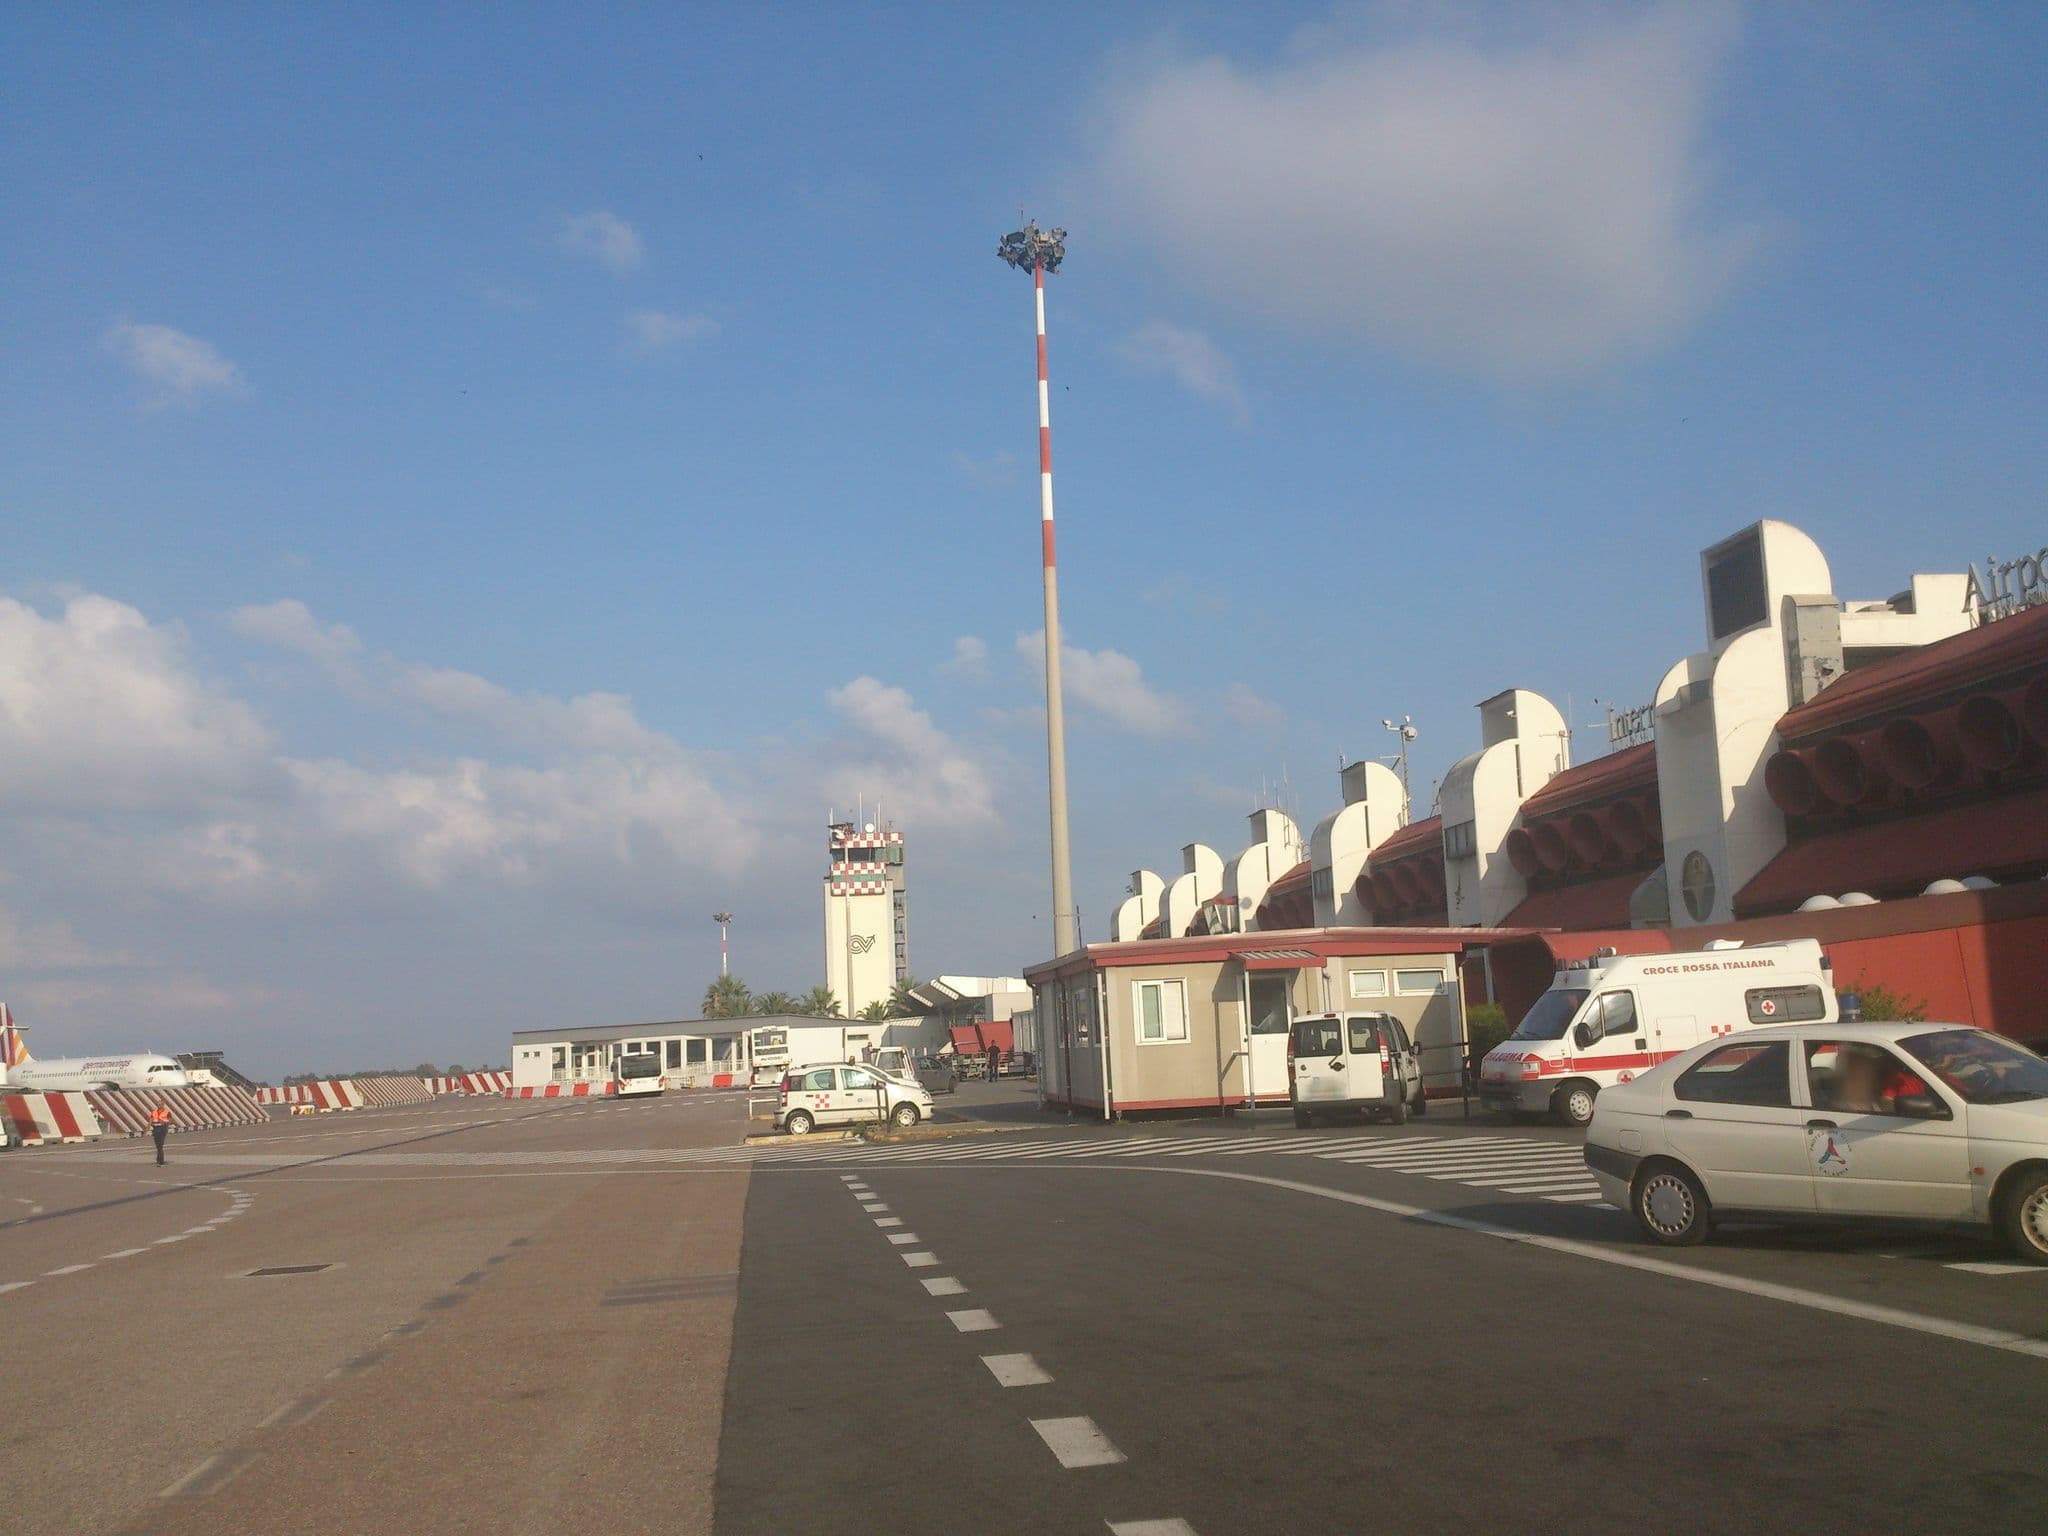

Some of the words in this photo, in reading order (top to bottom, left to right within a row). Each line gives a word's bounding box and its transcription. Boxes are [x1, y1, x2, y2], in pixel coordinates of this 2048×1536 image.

[1643, 966, 1679, 976] CROCE
[1683, 963, 1720, 973] ROSSA
[1723, 959, 1775, 970] ITALIANA
